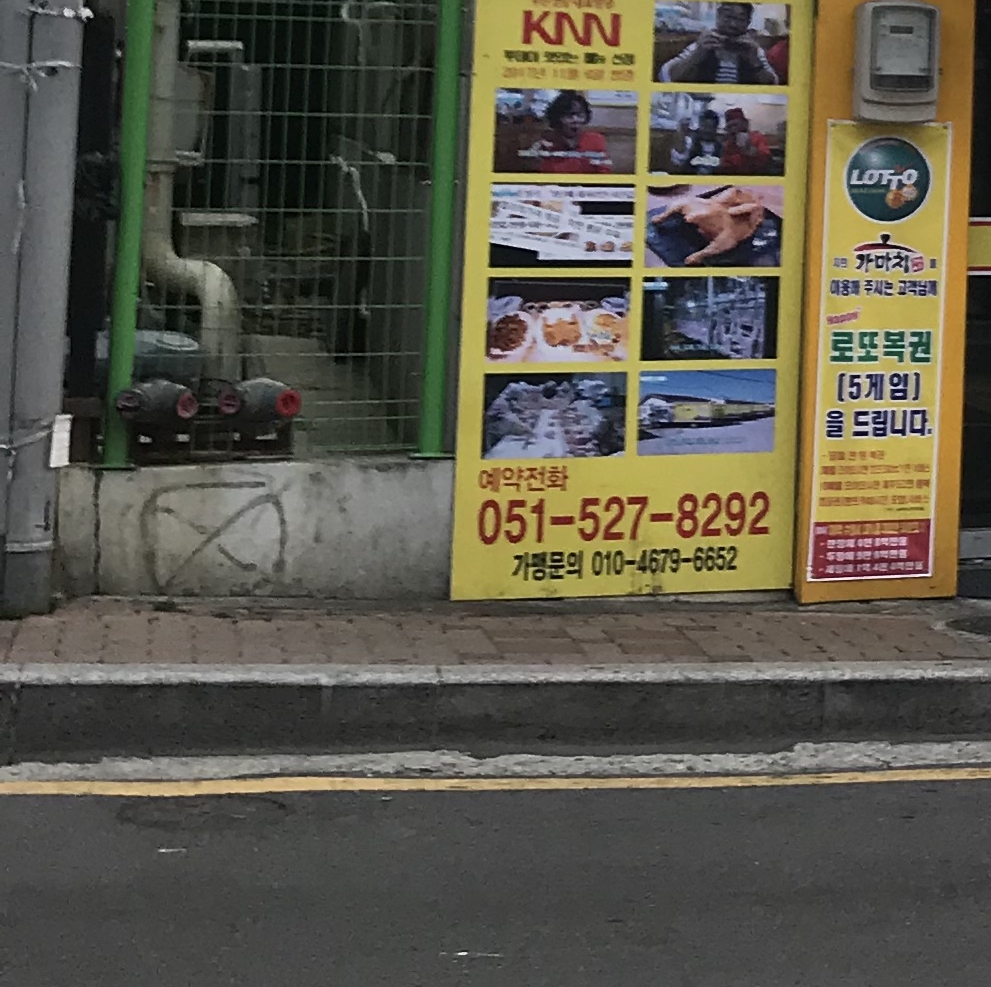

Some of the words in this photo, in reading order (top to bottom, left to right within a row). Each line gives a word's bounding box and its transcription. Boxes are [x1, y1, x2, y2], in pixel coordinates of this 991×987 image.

[521, 9, 622, 47] KNN
[850, 168, 919, 190] LOTTO
[855, 251, 910, 274] 가마치
[864, 279, 894, 296] 주시는
[829, 329, 932, 363] 로또복권
[825, 409, 844, 438] 을
[851, 409, 933, 438] 드립니다.
[477, 465, 569, 492] 예약전화
[477, 491, 770, 545] 051-527-8292
[512, 549, 584, 581] 가맹문의
[591, 545, 738, 576] 010-4679-6652
